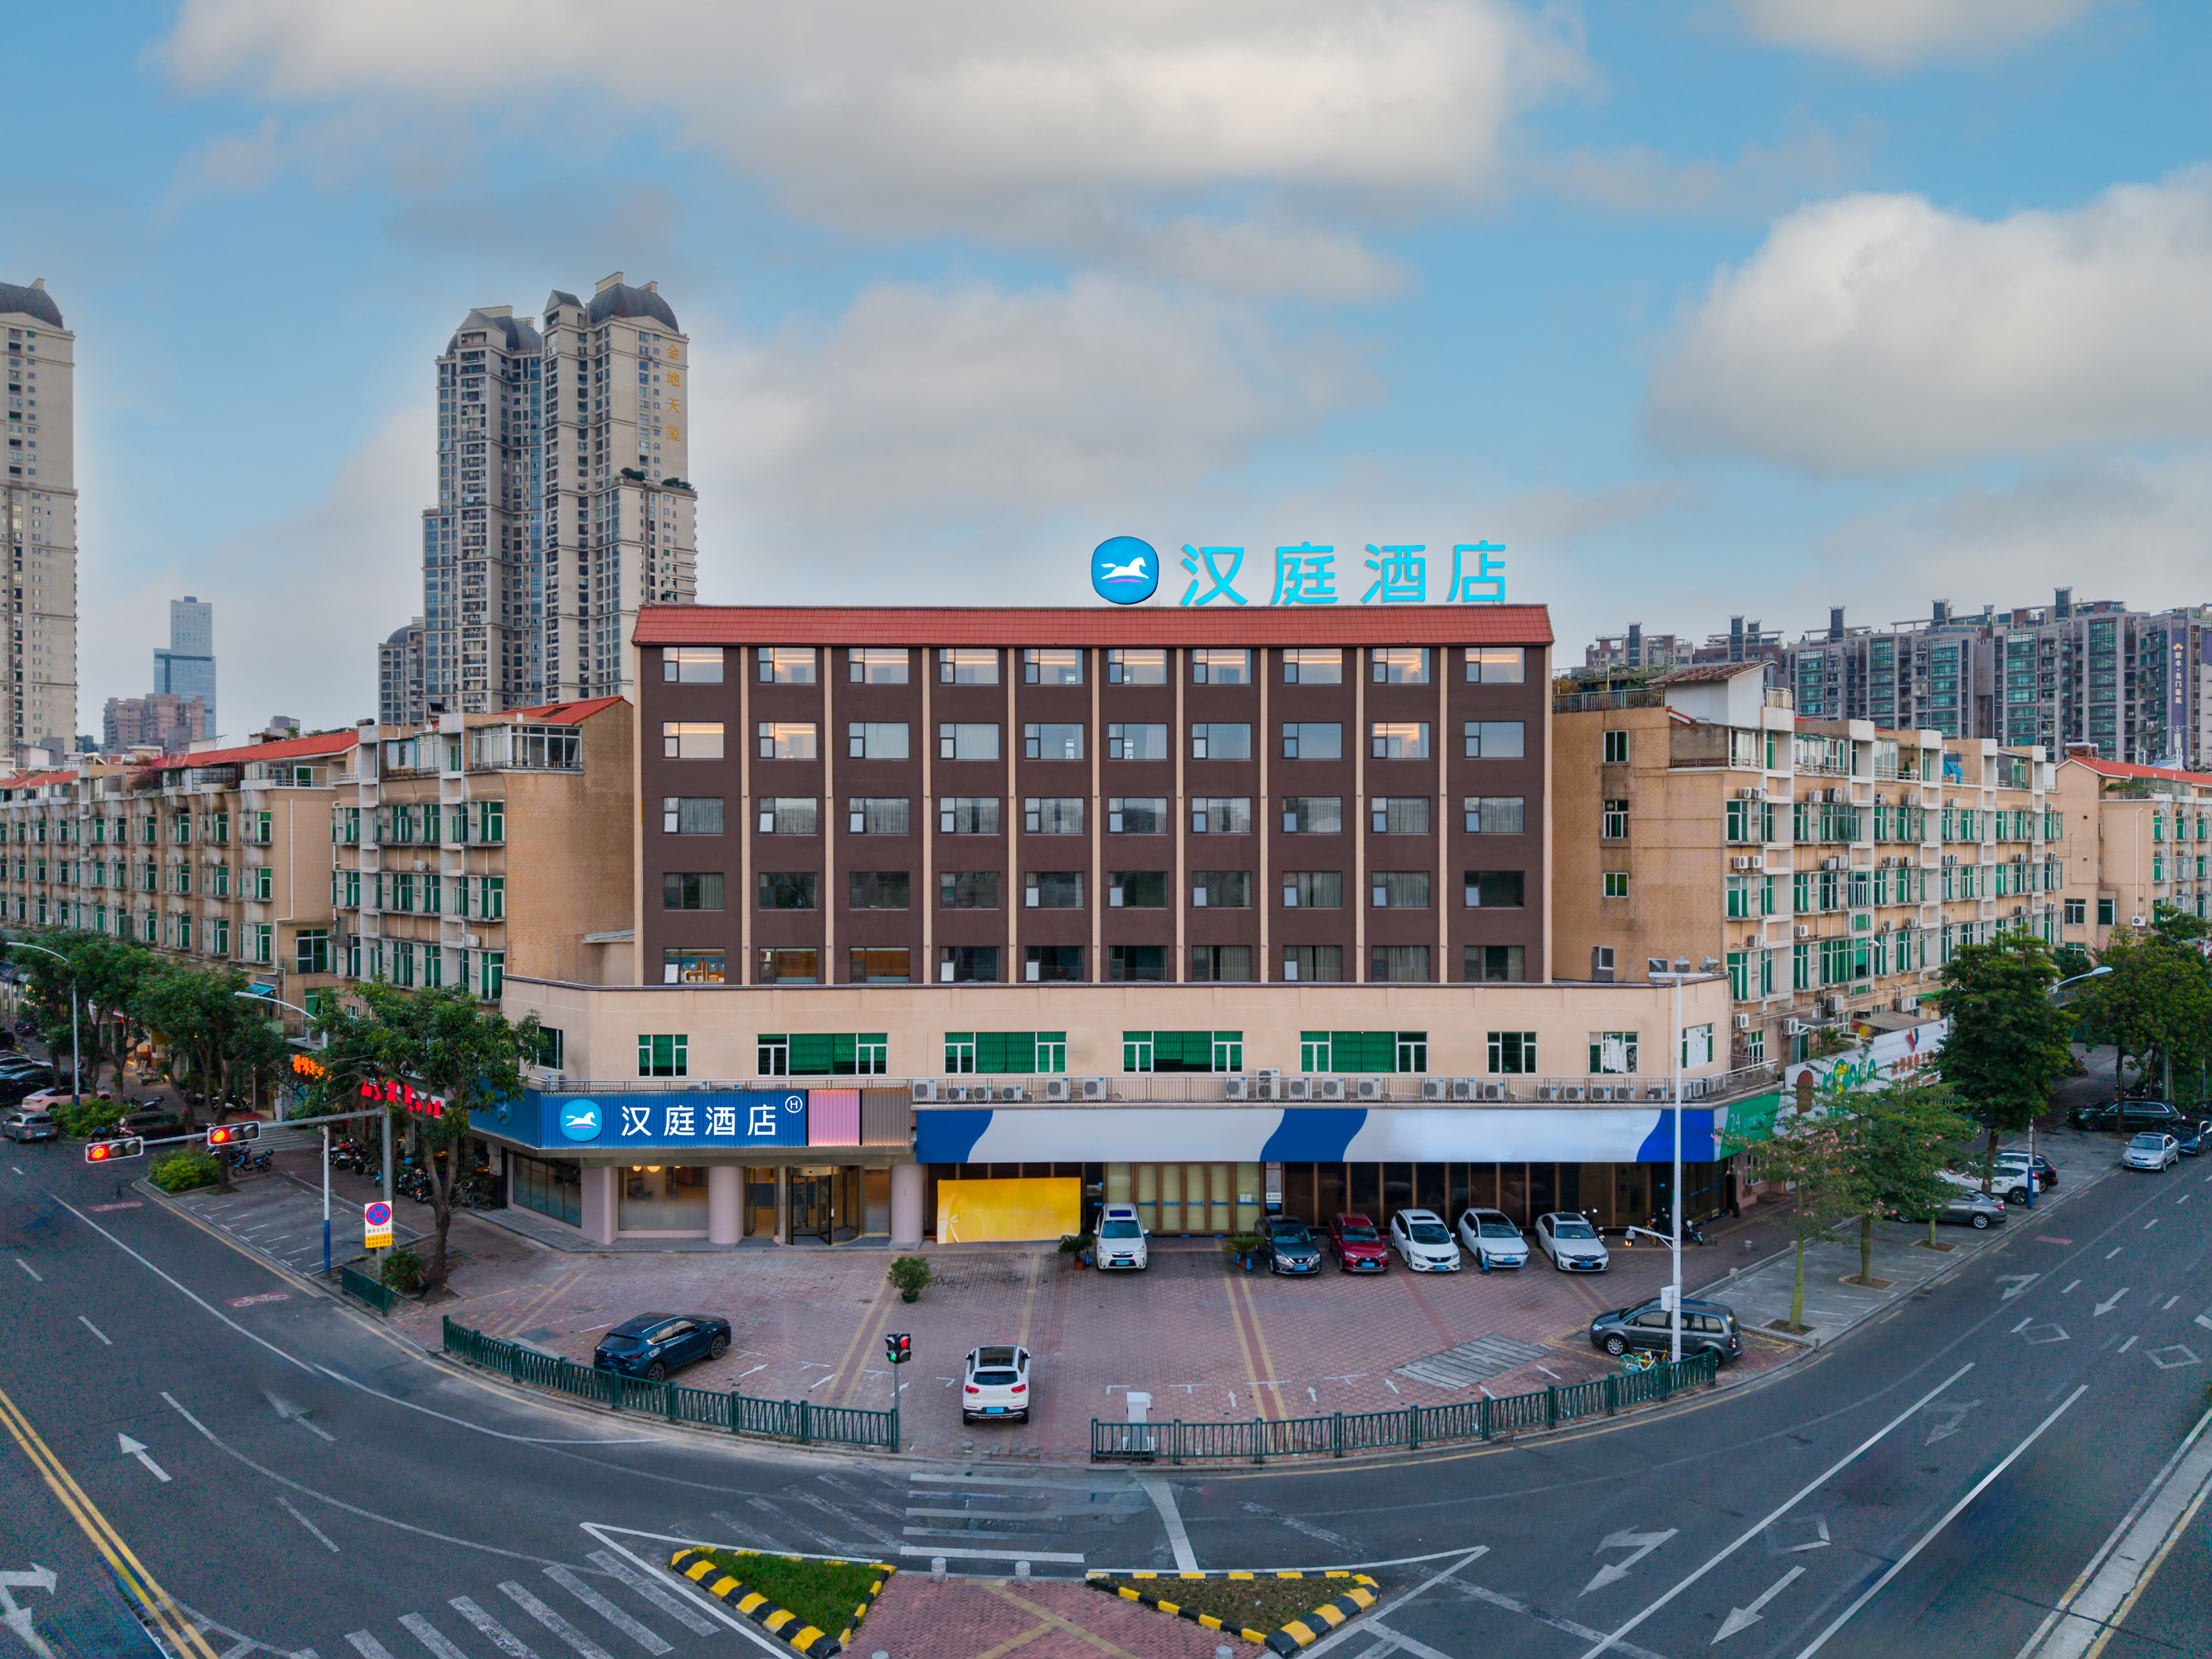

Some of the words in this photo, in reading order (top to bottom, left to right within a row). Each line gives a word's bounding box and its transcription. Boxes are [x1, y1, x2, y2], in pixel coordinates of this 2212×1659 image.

[666, 343, 680, 441] 金地天玺
[1181, 540, 1506, 606] 汉庭酒店
[621, 1104, 776, 1136] 汉庭酒店
[1730, 1112, 1741, 1132] 24
